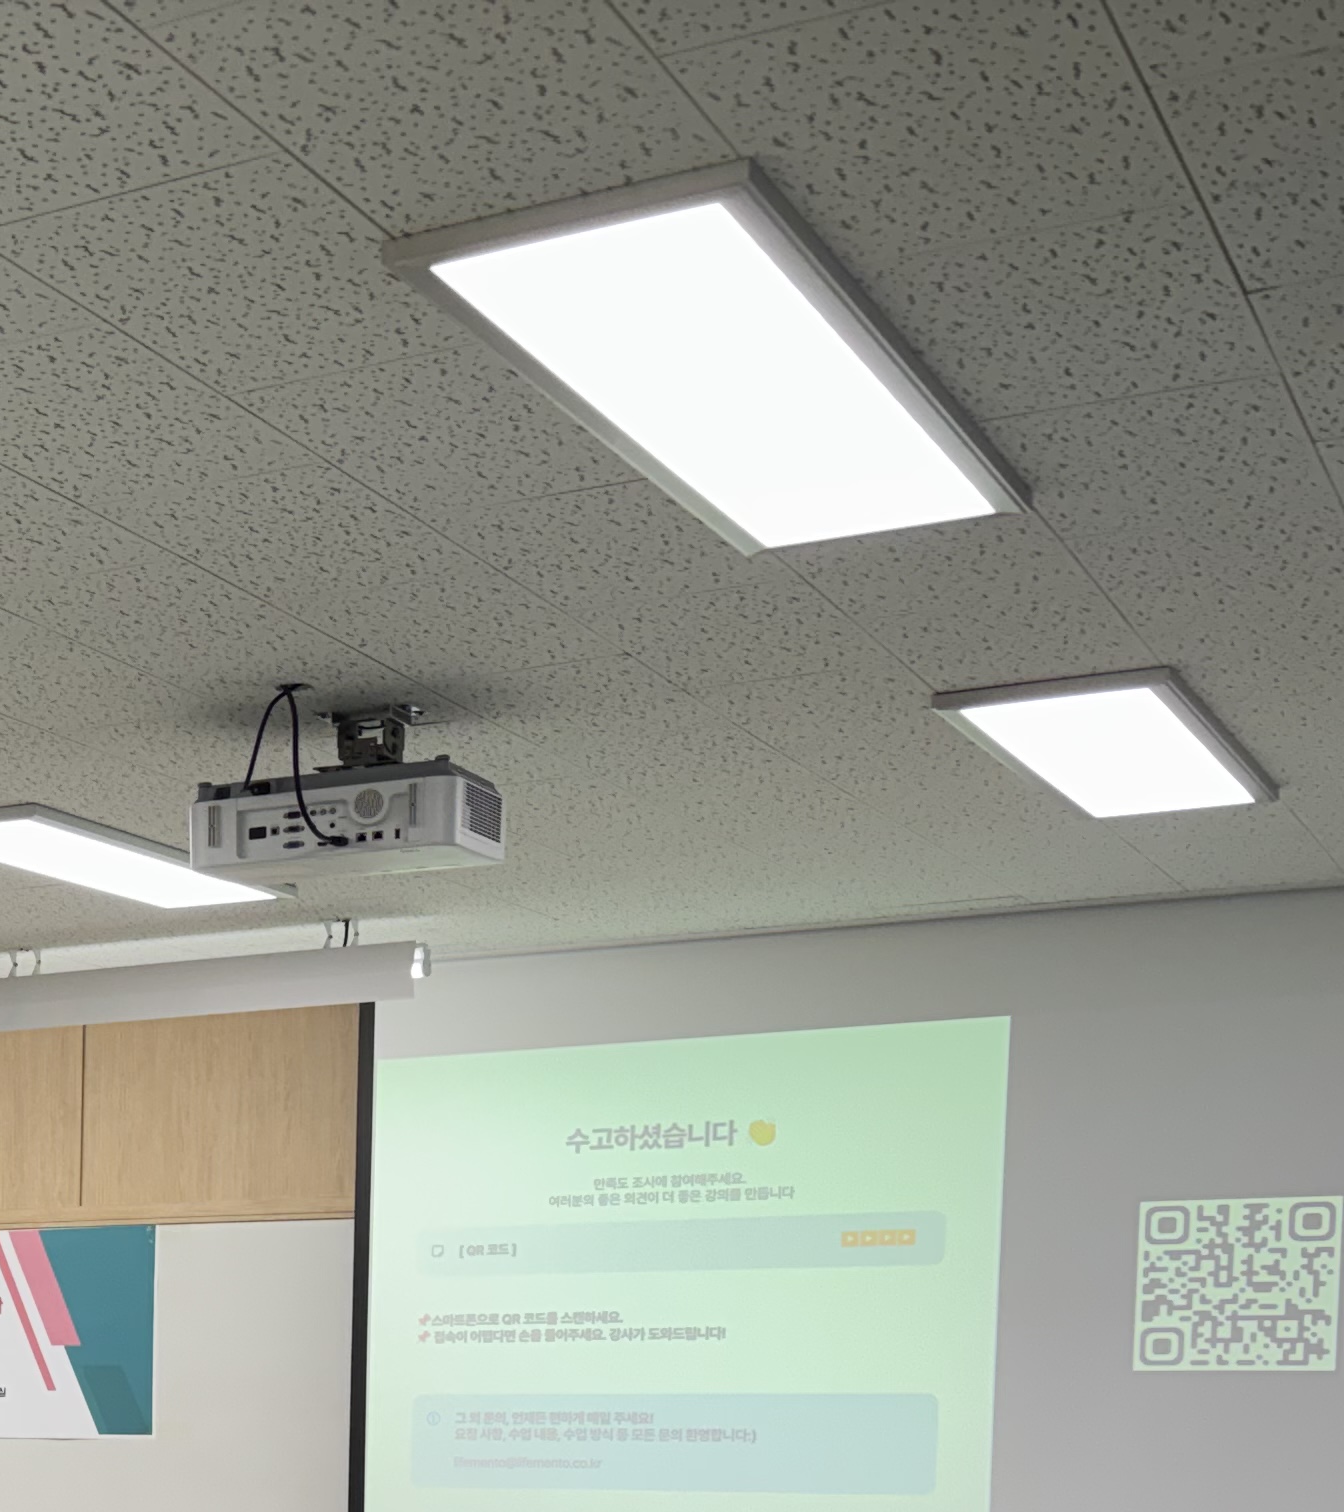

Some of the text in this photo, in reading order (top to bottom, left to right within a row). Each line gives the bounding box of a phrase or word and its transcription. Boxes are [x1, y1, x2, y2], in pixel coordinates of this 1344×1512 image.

[566, 1119, 738, 1154] 수고하셨습니다
[594, 1172, 747, 1190] 만족도 조사에 참여해주세요.
[549, 1186, 795, 1207] 여러분의 좋은 의견이 더 좋은 강의를 만듭니다
[466, 1244, 485, 1257] QR
[486, 1243, 510, 1256] 코드
[431, 1311, 623, 1327] 스마트폰으로 QR 코드를 스캔하세요.
[434, 1326, 726, 1344] 접속이 어렵다면 손을 들어주세요. 강사가 도와드립니다!
[549, 1412, 585, 1425] 편하게
[508, 1428, 531, 1441] 수업
[563, 1428, 587, 1441] 수업
[589, 1428, 613, 1441] 방식
[631, 1428, 655, 1441] 모든
